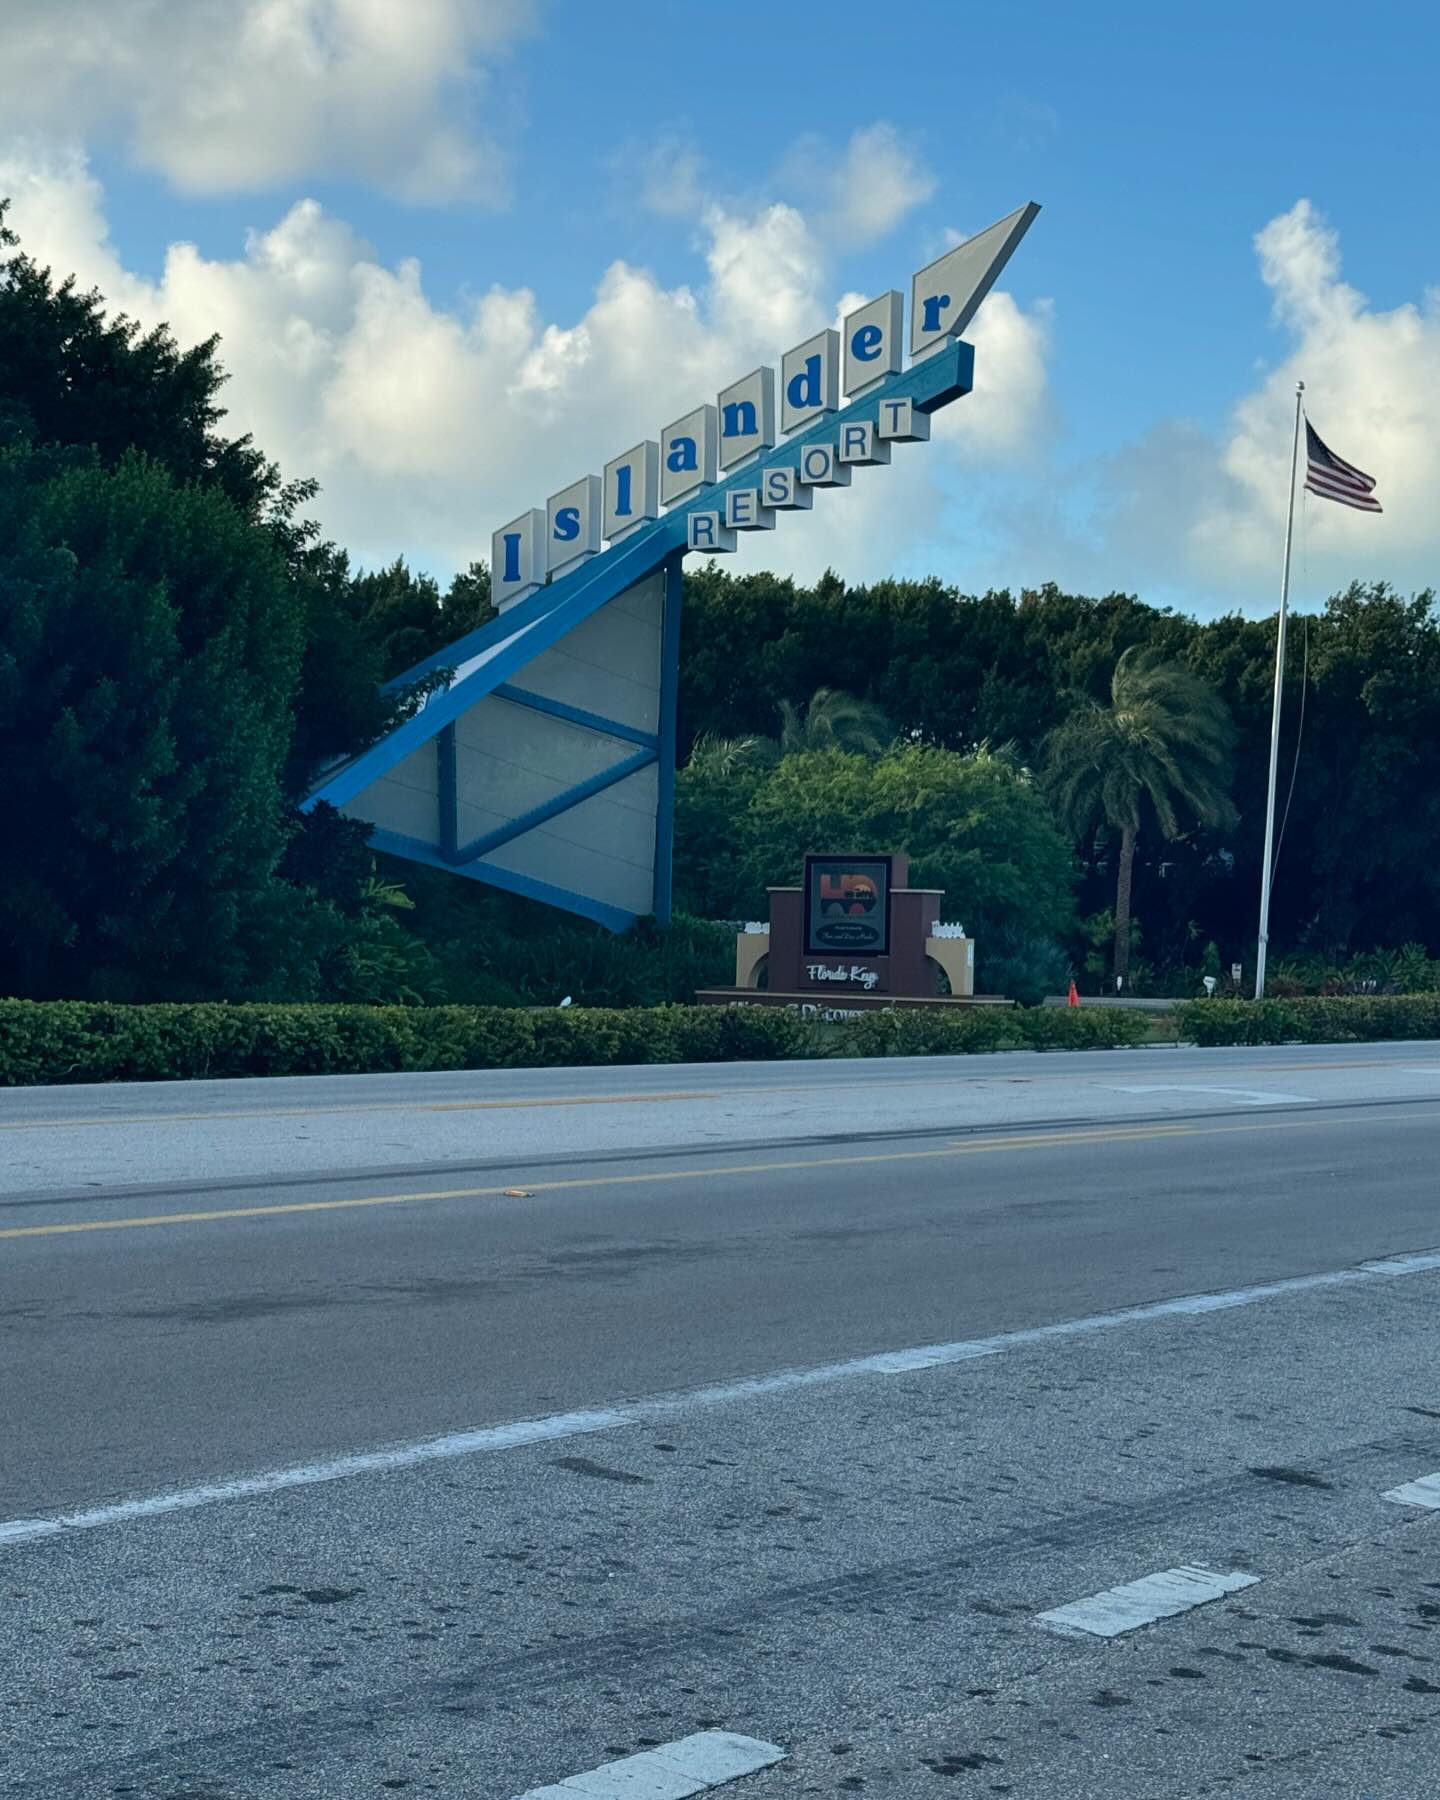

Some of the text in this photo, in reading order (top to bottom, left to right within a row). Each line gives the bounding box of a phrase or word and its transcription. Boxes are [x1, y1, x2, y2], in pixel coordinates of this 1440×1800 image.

[502, 293, 951, 583] Islander
[693, 402, 908, 545] RESORT
[806, 965, 848, 980] Florida
